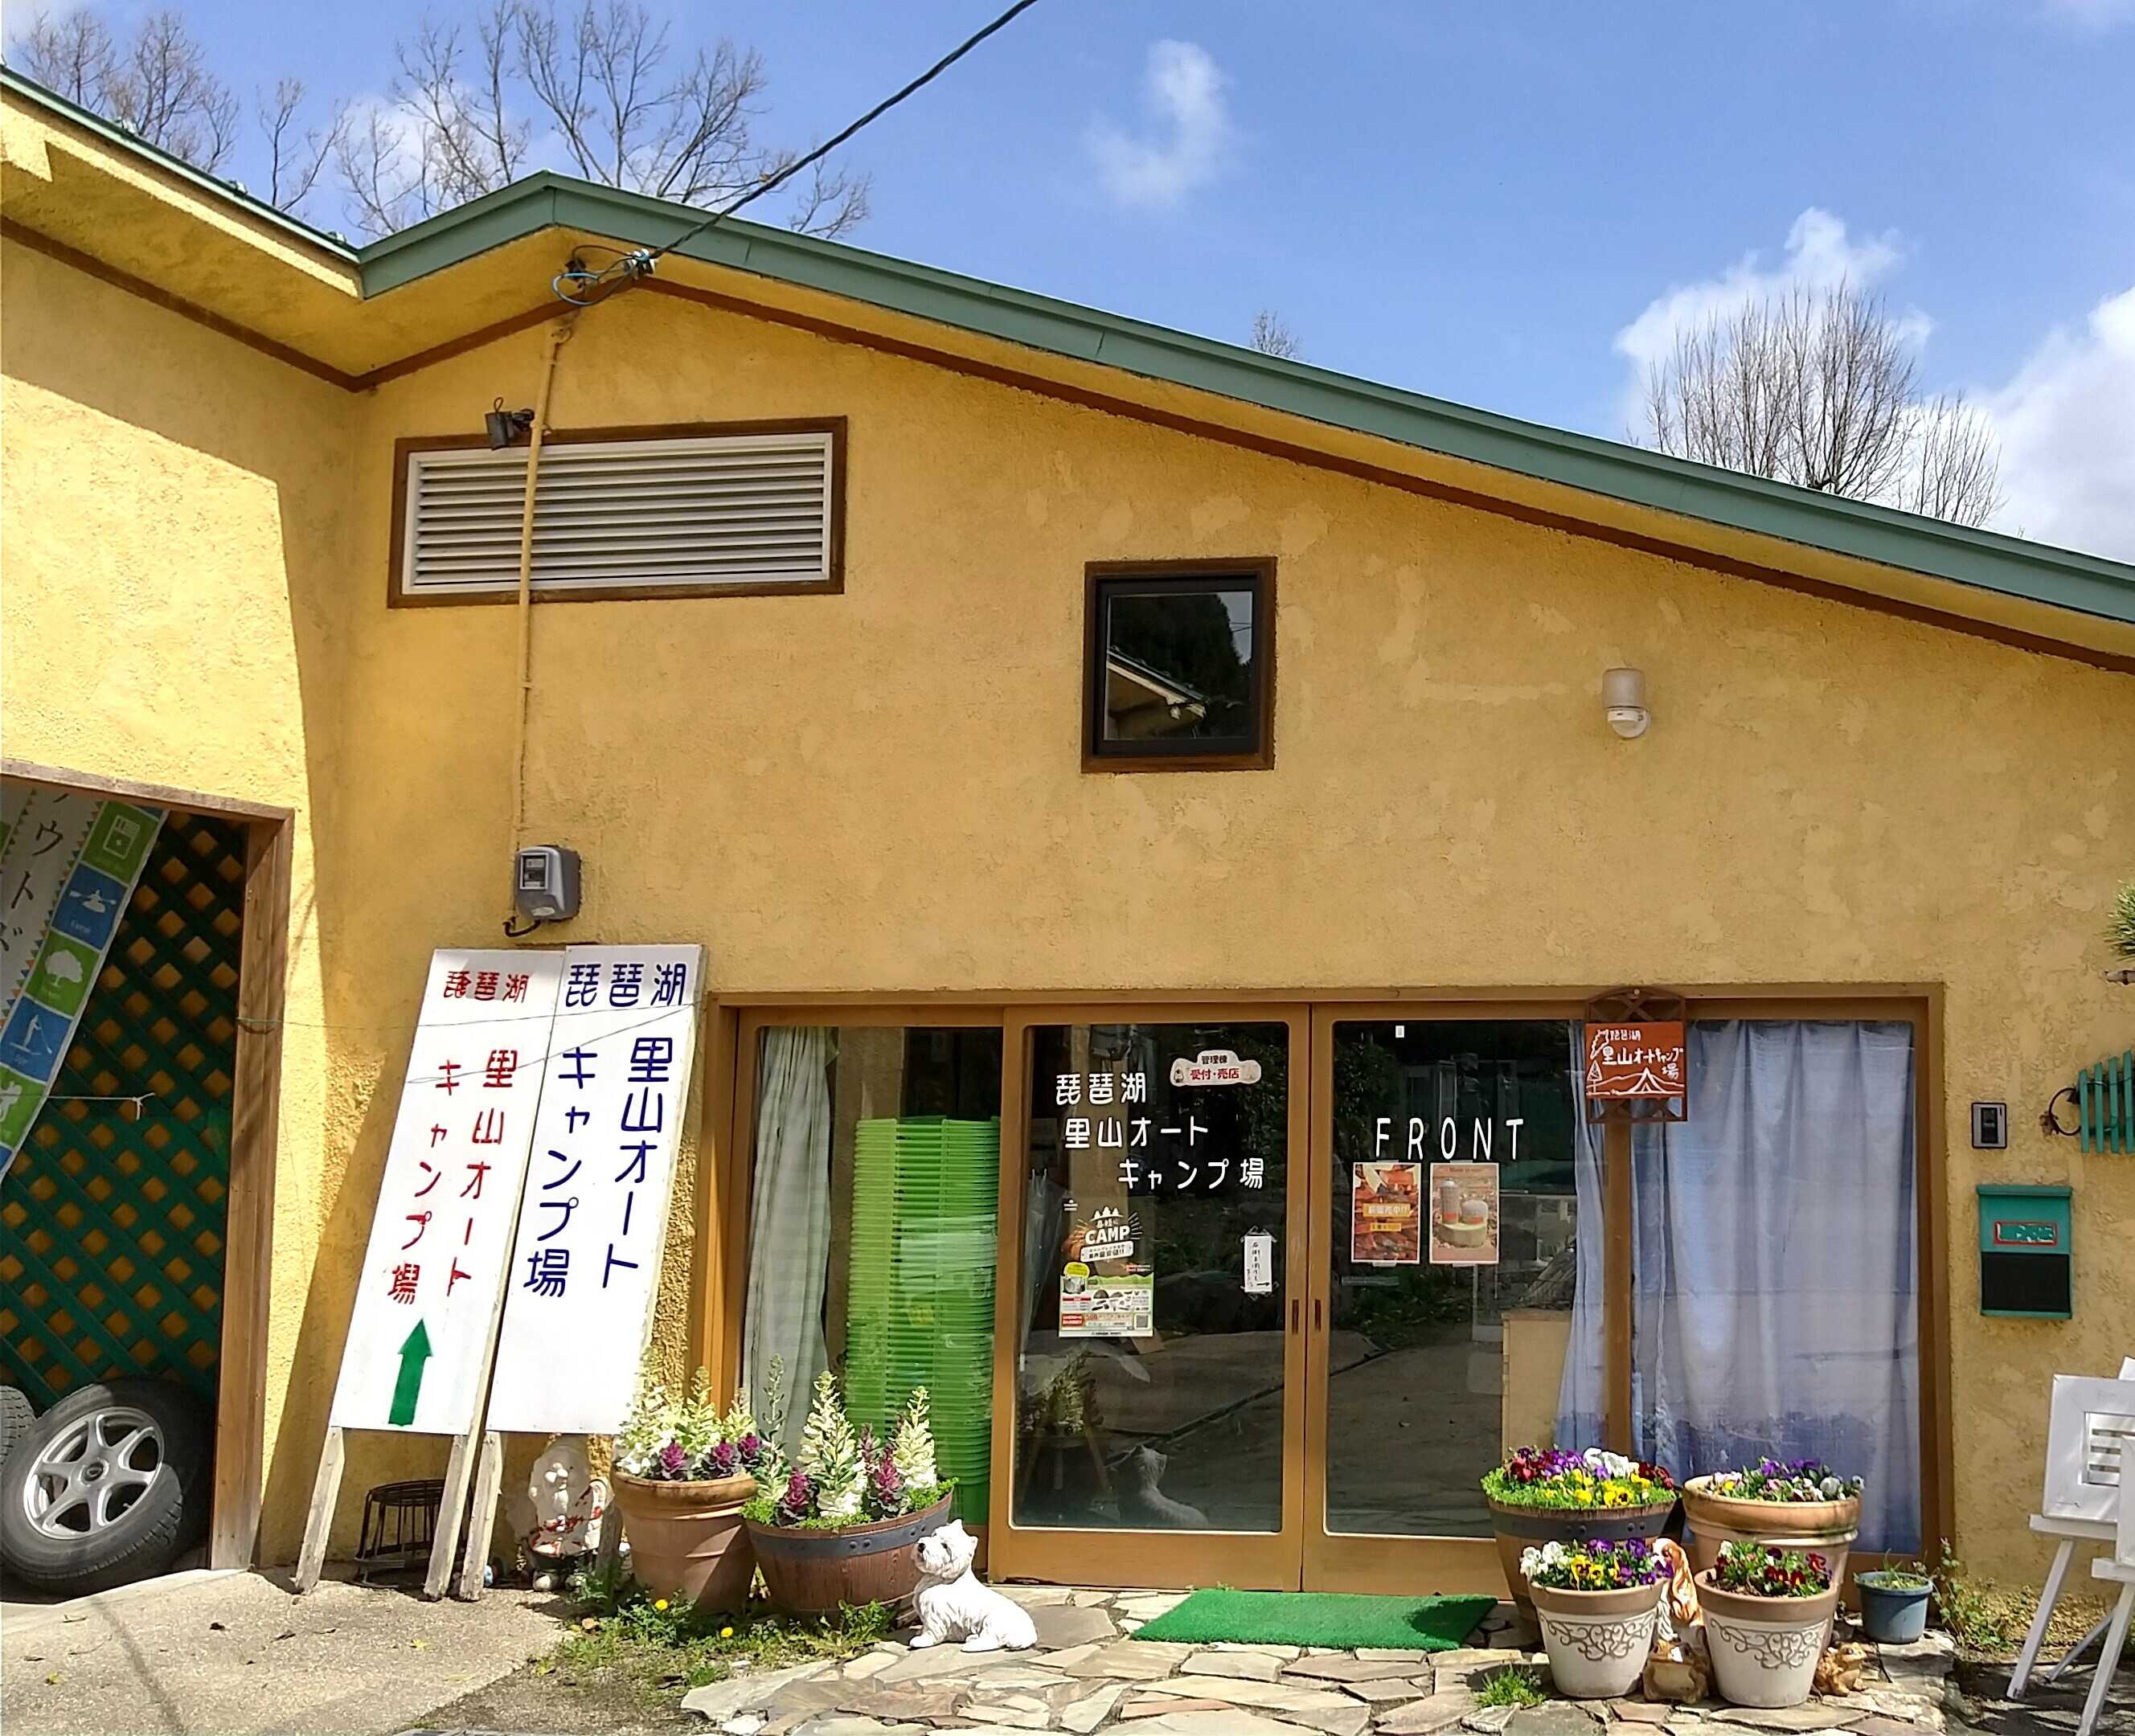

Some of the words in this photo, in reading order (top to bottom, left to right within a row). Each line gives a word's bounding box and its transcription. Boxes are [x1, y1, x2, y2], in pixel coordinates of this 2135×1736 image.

[443, 971, 529, 1003] 琵琶湖
[564, 963, 687, 1008] 琵琶湖
[1602, 1046, 1684, 1065] 里山オートキャンプ
[1055, 1072, 1146, 1106] 琵琶湖
[1065, 1116, 1208, 1149] 里山オート
[1375, 1116, 1524, 1161] FRONT
[447, 1049, 518, 1297] 里山オート
[523, 1046, 599, 1298] キャンプ場
[604, 1037, 674, 1288] 里山オート
[1117, 1157, 1264, 1189] キャンプ場
[387, 1060, 461, 1305] キャンプ場
[1084, 1225, 1131, 1245] CAMP
